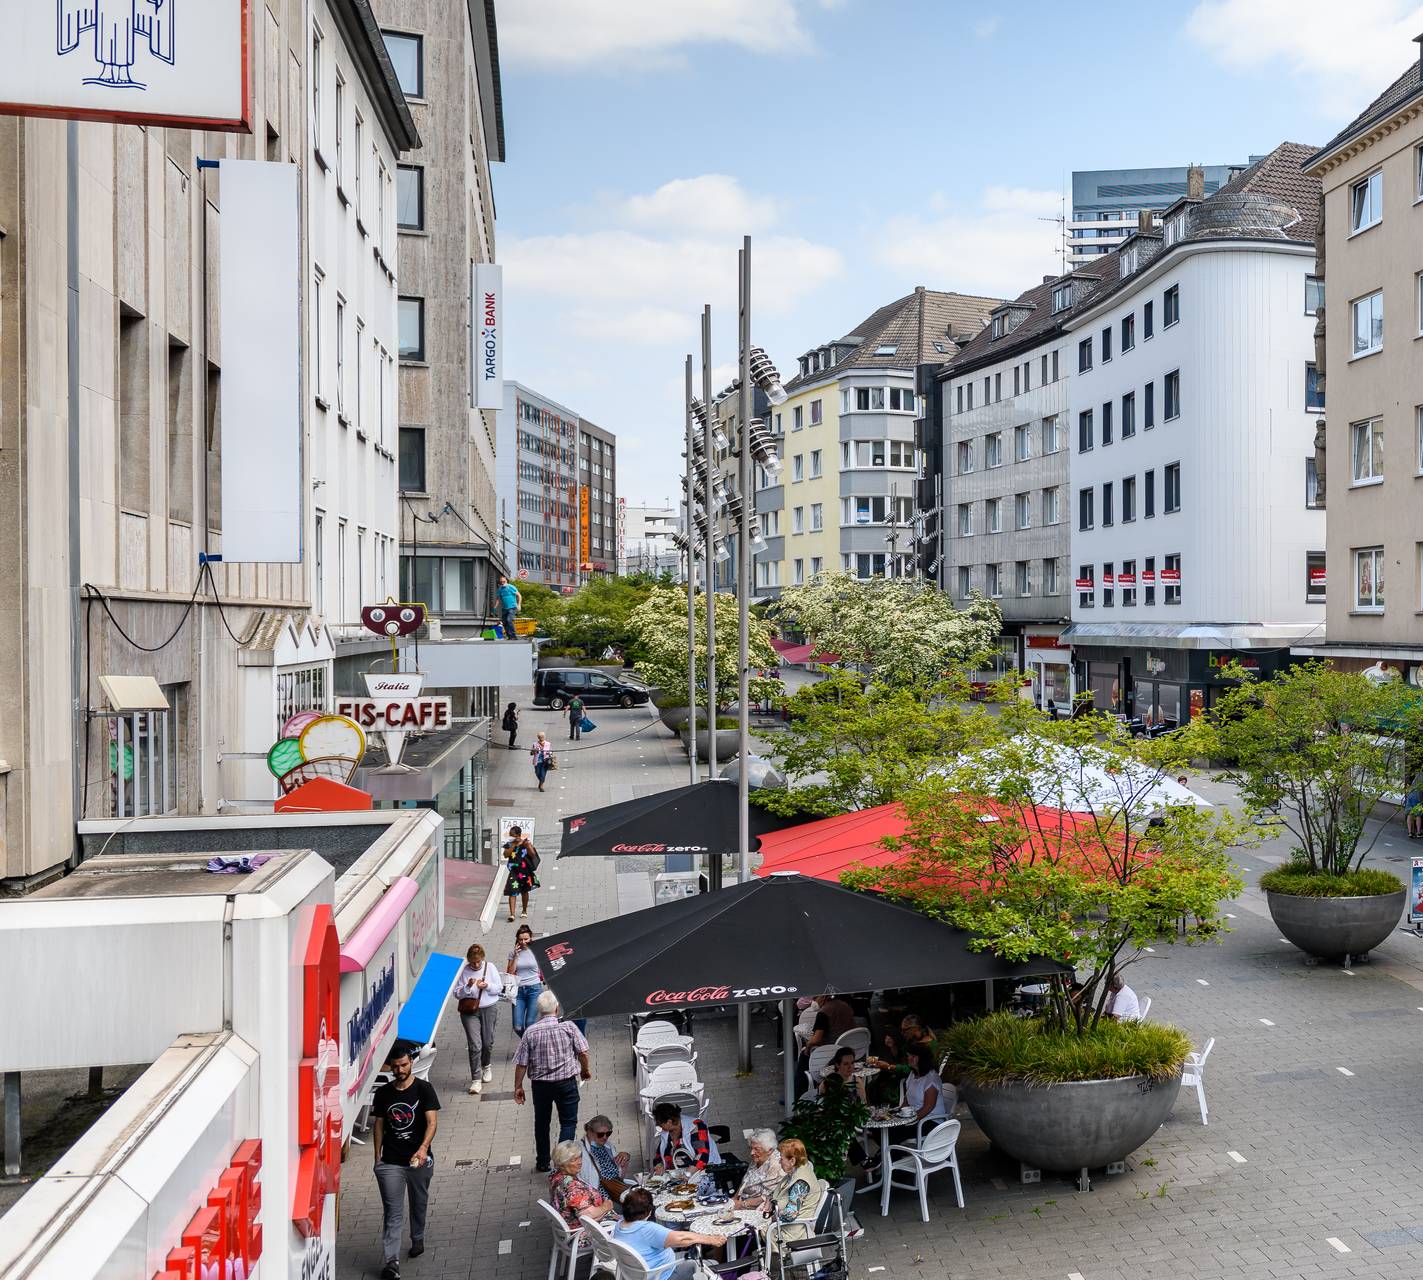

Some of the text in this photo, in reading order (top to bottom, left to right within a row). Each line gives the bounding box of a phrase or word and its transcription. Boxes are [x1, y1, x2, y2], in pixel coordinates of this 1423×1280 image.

[485, 292, 496, 380] TARGO BANK
[374, 681, 410, 690] Italia
[612, 843, 667, 853] Coca-Cola
[645, 985, 732, 1006] Coca-Cola
